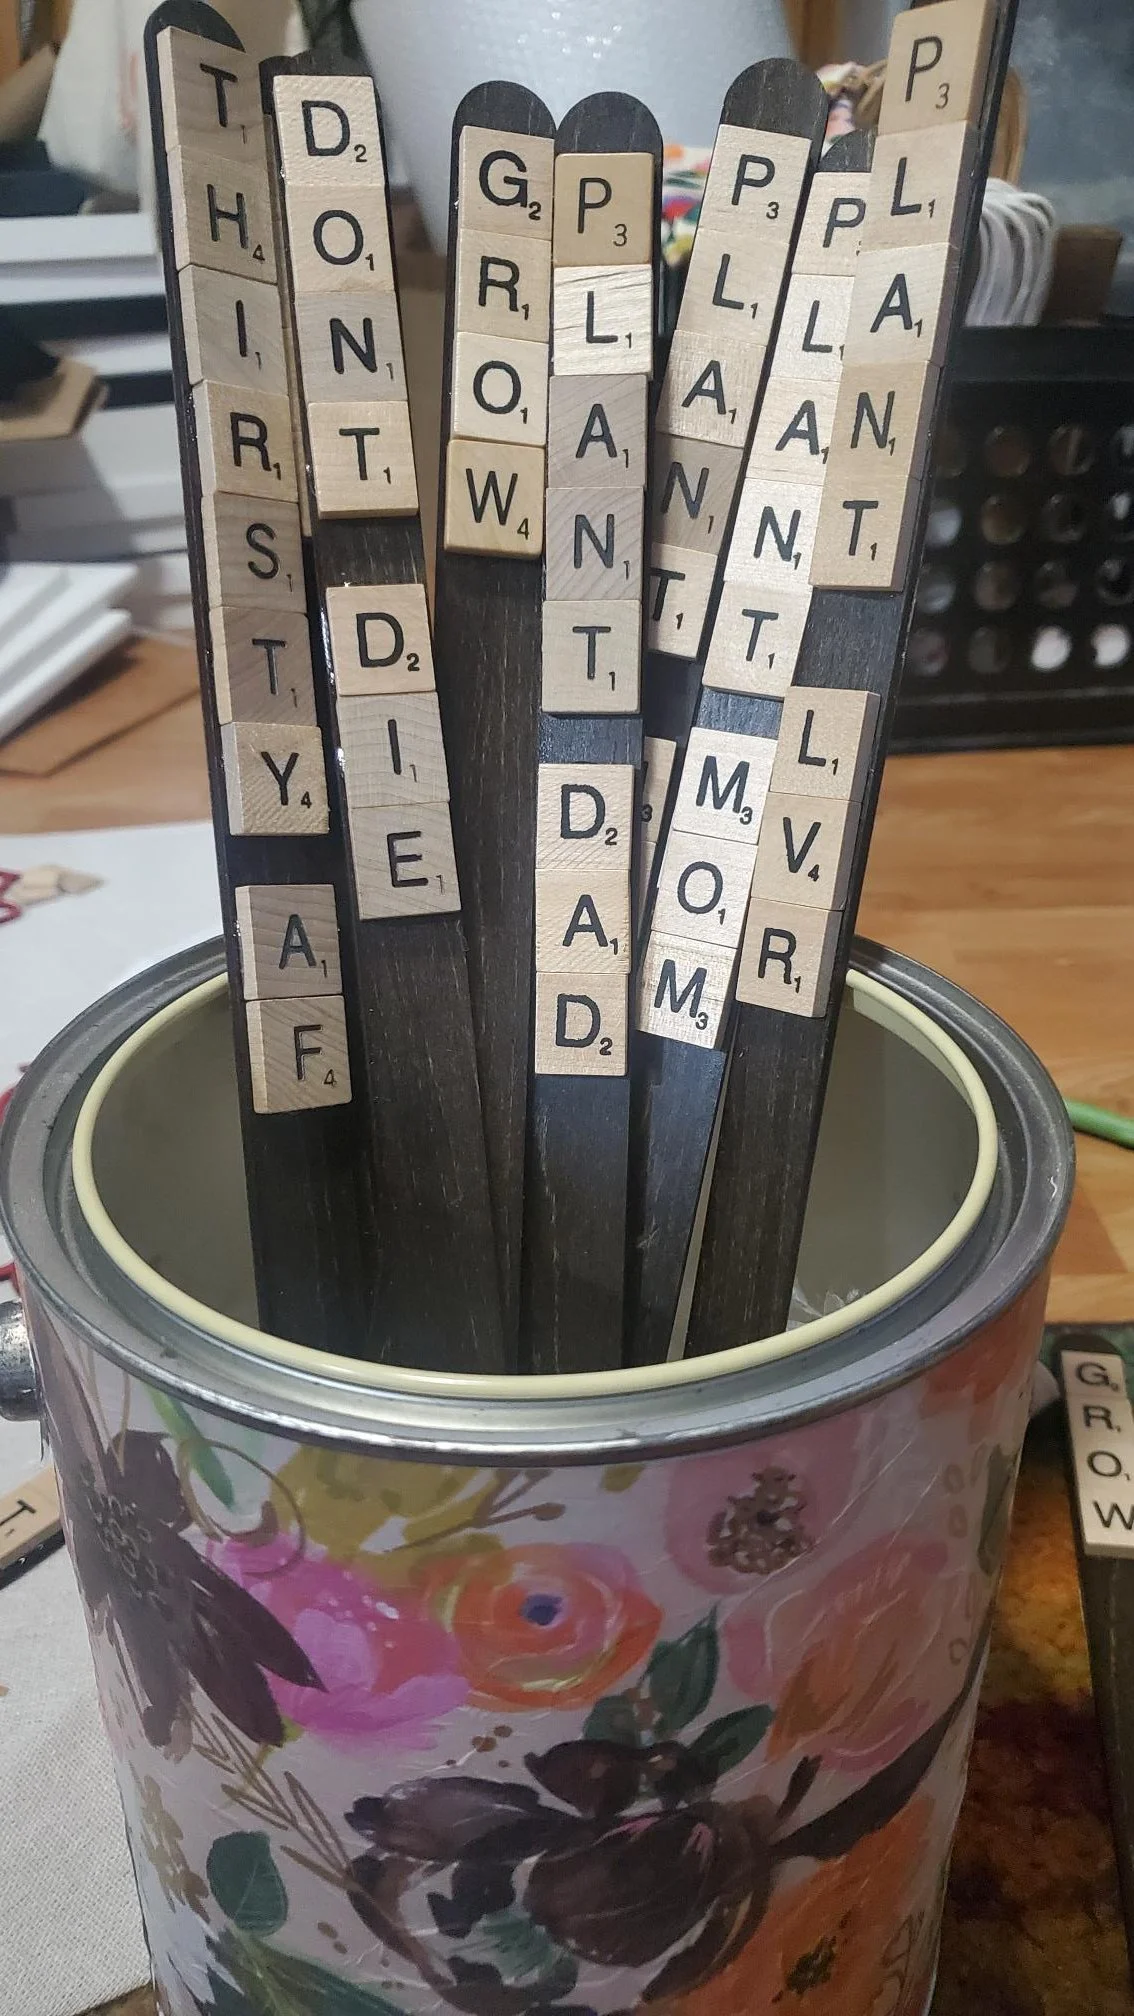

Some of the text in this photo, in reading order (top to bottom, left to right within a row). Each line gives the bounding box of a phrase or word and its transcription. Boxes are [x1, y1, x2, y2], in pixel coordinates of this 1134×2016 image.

[200, 63, 321, 1080] THIRSTY AF
[302, 100, 428, 887] DONT DIE
[466, 151, 529, 526] GROW
[556, 178, 618, 1047] PLANT DAD
[649, 155, 775, 621] PLANT
[654, 198, 866, 1017] PLANT MOM
[758, 36, 943, 984] PLANT LVR
[1076, 1362, 1134, 1530] GROW
